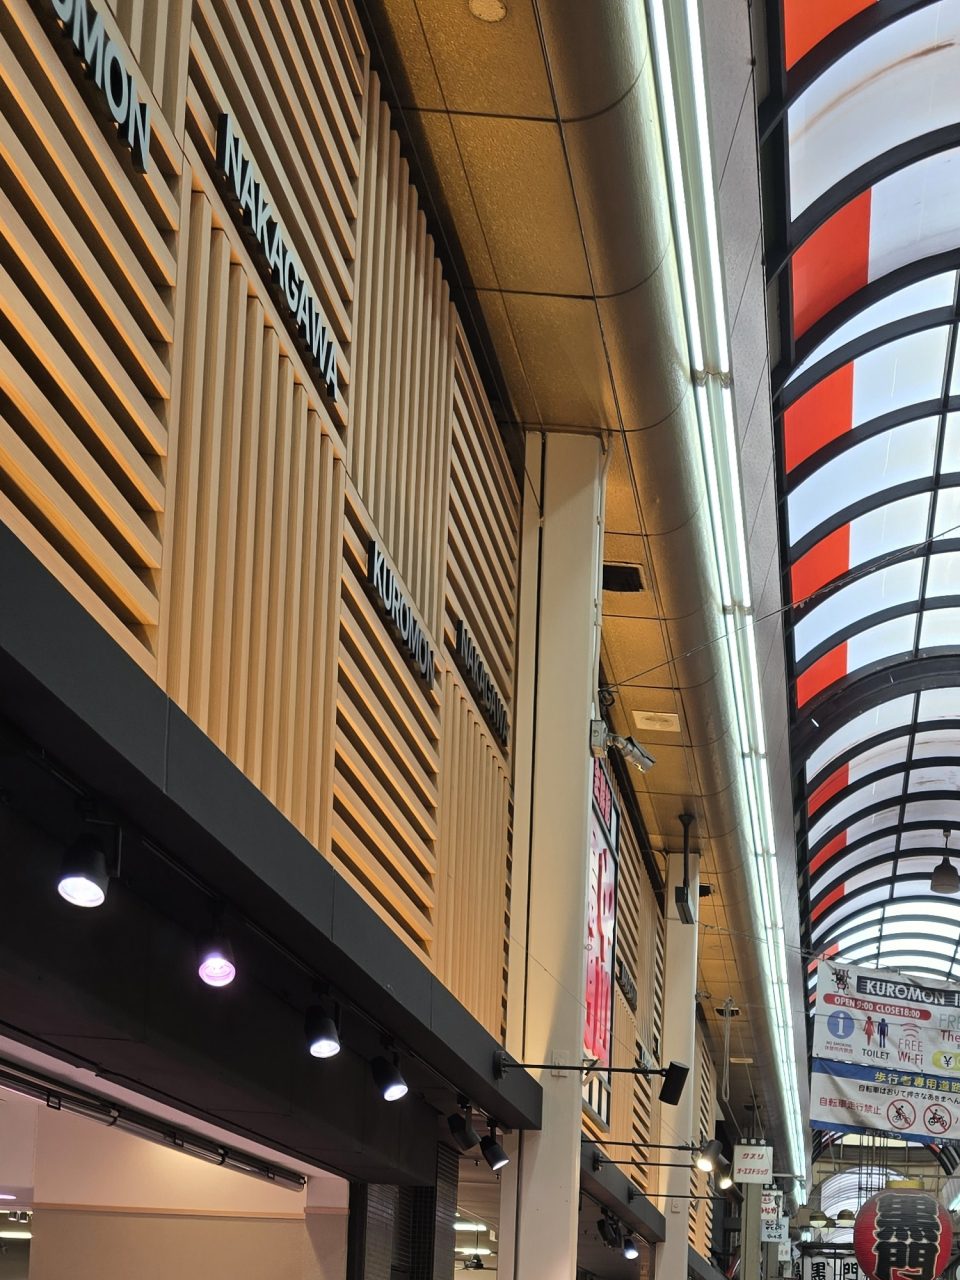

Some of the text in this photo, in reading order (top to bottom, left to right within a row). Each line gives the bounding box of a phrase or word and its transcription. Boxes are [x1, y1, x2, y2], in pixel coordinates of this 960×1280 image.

[220, 113, 338, 402] NAKAGAWA
[371, 544, 435, 690] KUROMON
[459, 621, 510, 747] NAKAGAWA
[866, 979, 946, 1005] KUROMON
[834, 996, 855, 1008] OPEN
[856, 1001, 873, 1011] 9:00
[861, 1048, 890, 1060] TOILET
[899, 1038, 923, 1052] FREE
[897, 1051, 924, 1065] Wi-Fi
